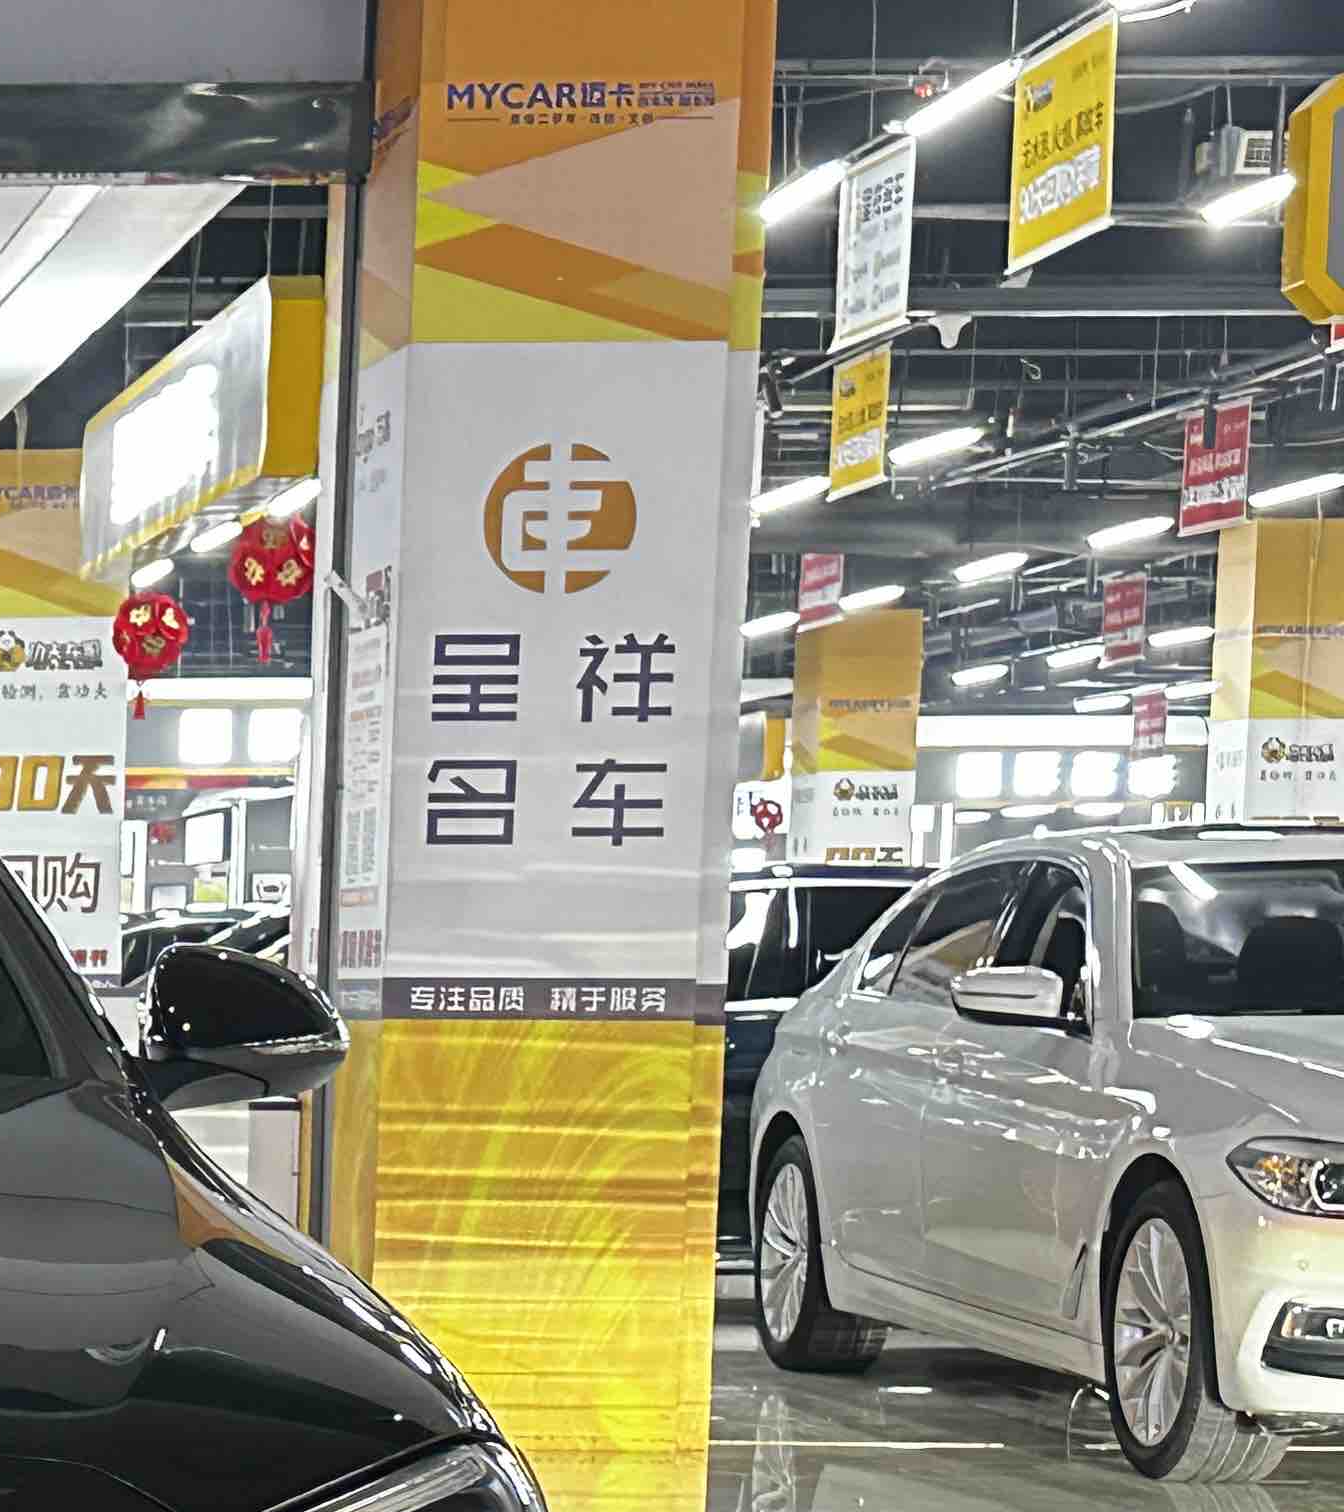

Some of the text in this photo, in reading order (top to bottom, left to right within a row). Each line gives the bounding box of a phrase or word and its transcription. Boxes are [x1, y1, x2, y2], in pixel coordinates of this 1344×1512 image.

[430, 633, 677, 723] 呈祥
[425, 758, 669, 848] 名车
[410, 985, 667, 1013] 专注品质 精于服务
